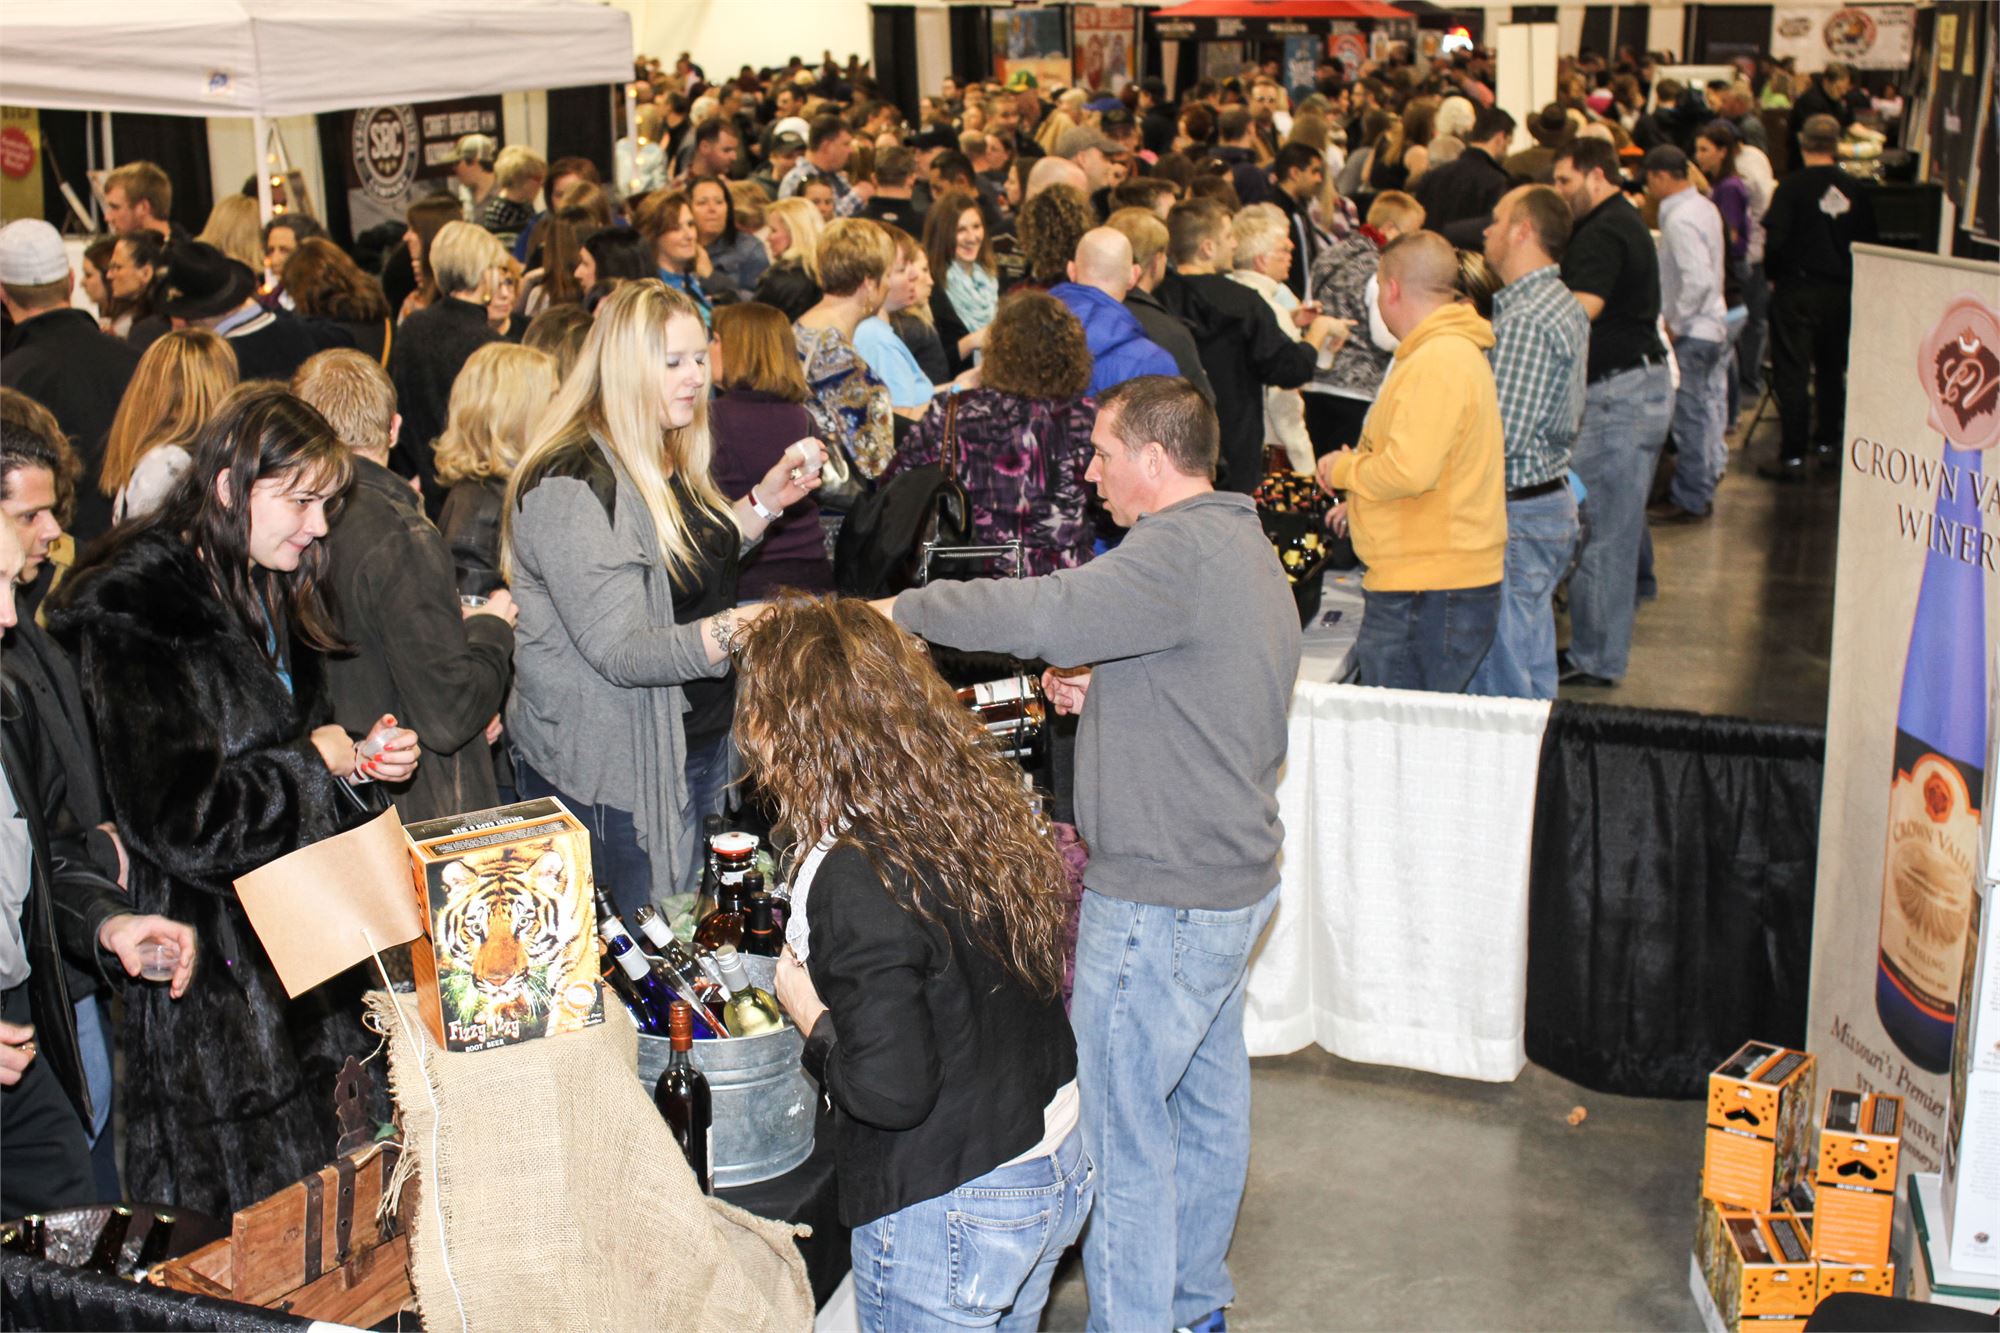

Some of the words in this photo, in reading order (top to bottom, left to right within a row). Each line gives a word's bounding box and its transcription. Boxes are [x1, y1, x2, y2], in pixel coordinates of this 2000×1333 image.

[369, 121, 402, 159] SBC
[1851, 437, 1960, 504] CROWN
[1898, 503, 2000, 573] WINER
[448, 1019, 487, 1042] Fizzy
[465, 1044, 483, 1052] ROOT
[487, 1038, 504, 1048] BEER
[1831, 1015, 1892, 1079] Missouri's
[1896, 1065, 1945, 1119] Premier
